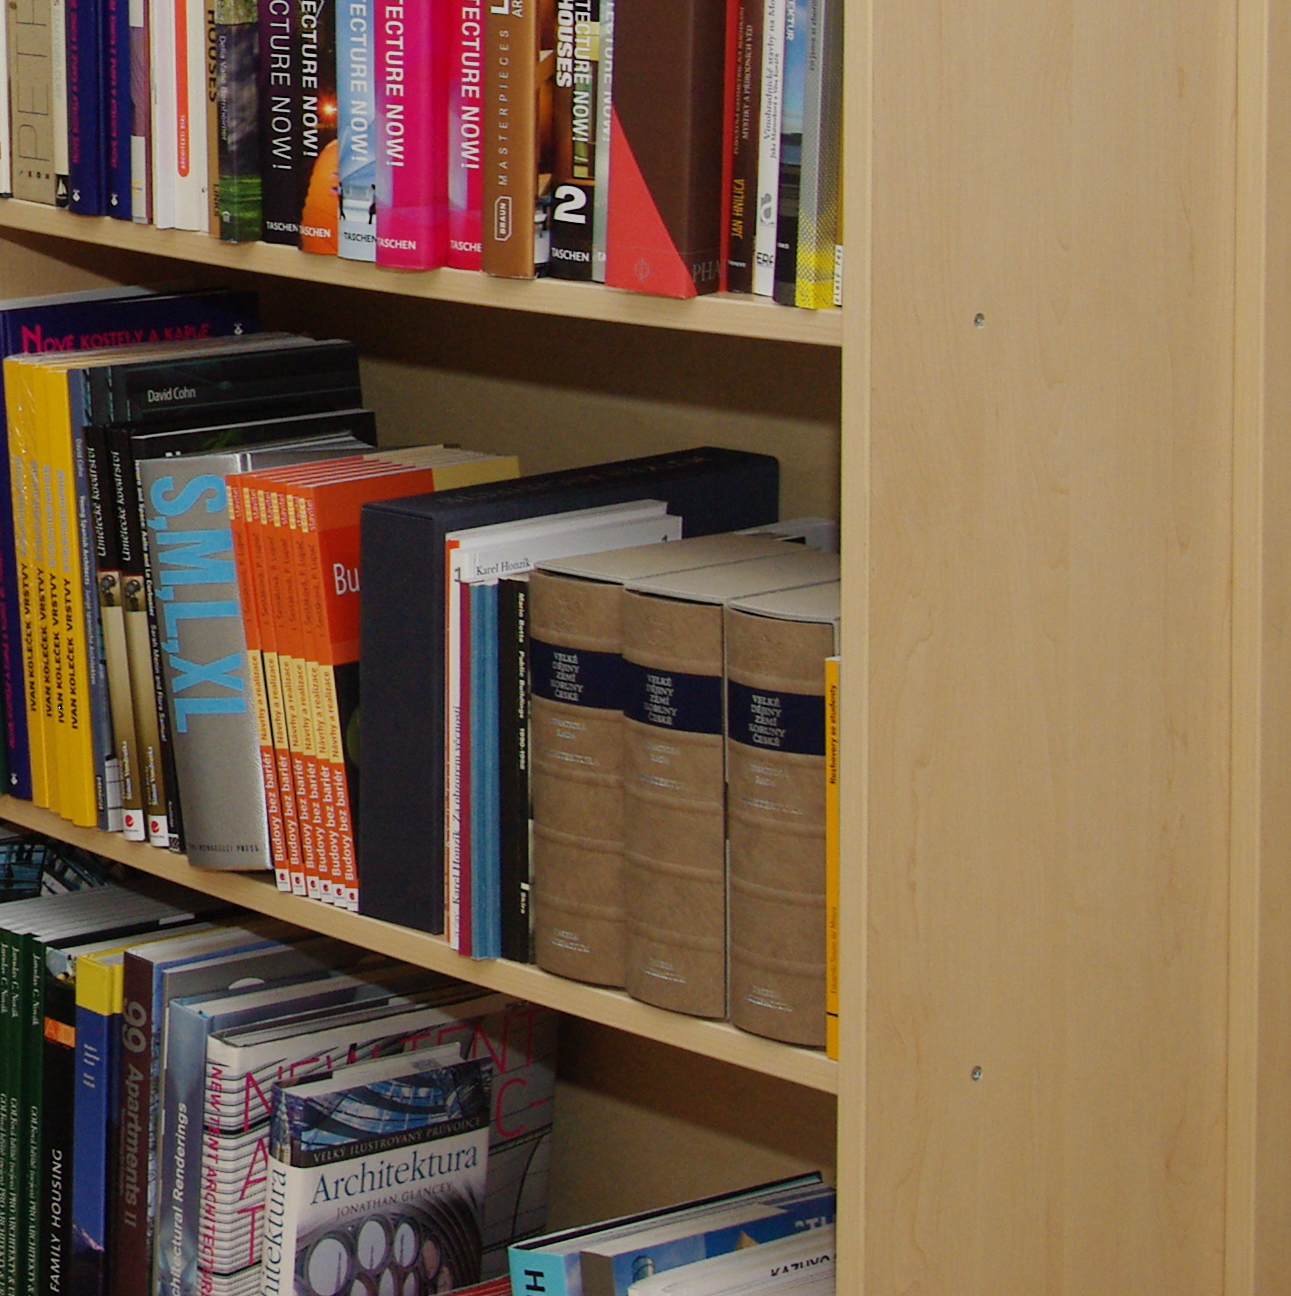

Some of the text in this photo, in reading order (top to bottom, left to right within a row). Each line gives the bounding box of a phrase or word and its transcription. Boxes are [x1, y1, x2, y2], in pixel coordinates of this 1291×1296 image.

[386, 104, 405, 168] NOW!
[553, 185, 587, 224] 2
[147, 385, 196, 402] David Cohn
[476, 558, 531, 576] Karel Honzík
[149, 472, 247, 734] S,M,L,XL
[334, 768, 354, 882] Budovy bez bariér
[124, 1063, 144, 1206] Apartments
[313, 1115, 482, 1164] VELKÝ ILUSTROVANÝ PRŮVODCE
[310, 1143, 478, 1206] Architektura
[49, 1148, 63, 1293] FAMILY HOUSING
